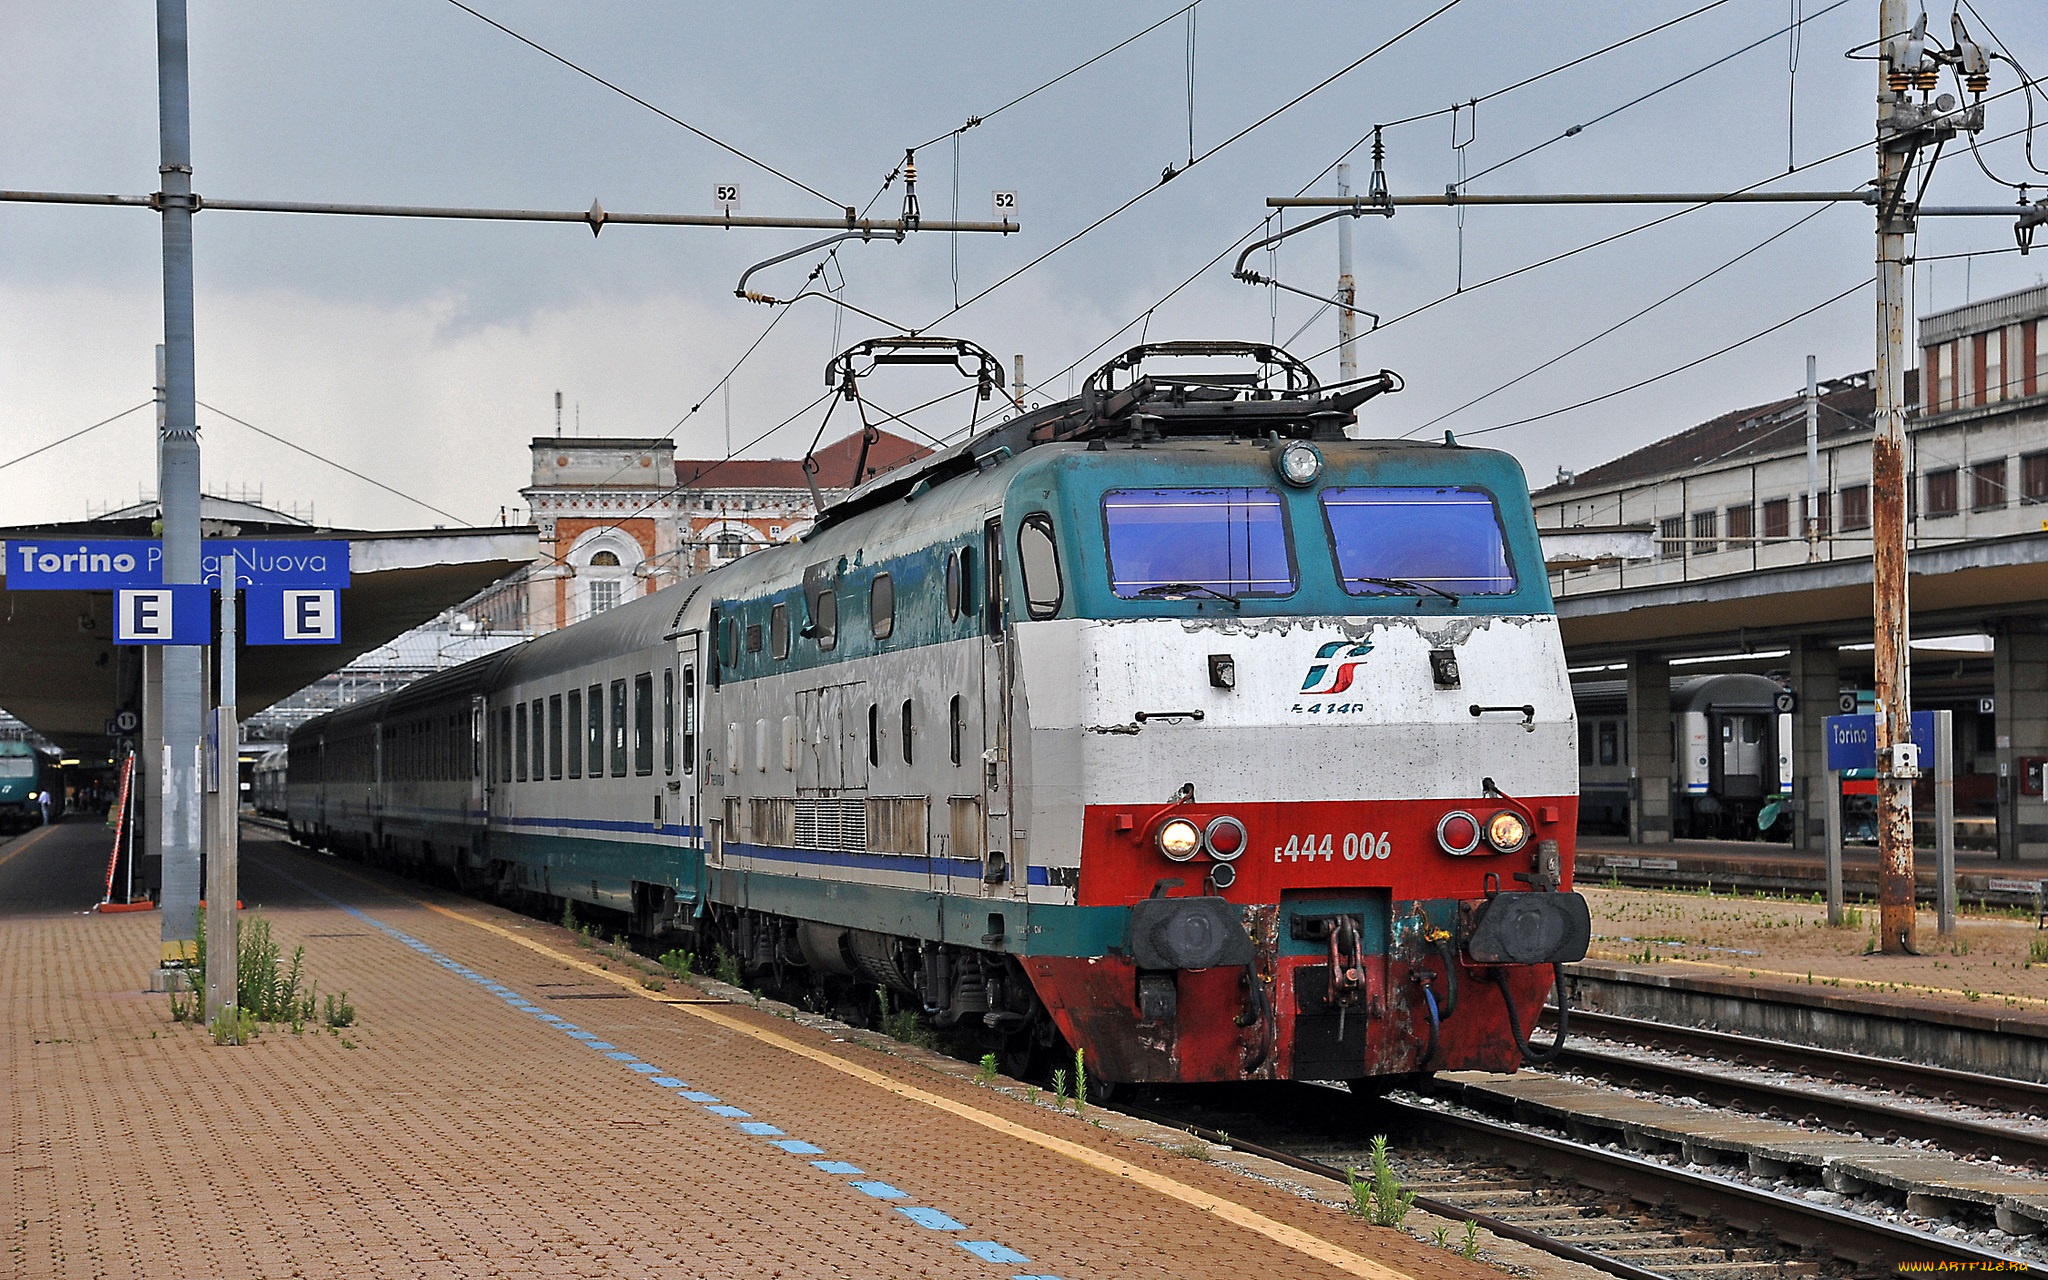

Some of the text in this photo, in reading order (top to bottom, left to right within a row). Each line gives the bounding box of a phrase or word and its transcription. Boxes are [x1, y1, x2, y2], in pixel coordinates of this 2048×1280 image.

[717, 186, 737, 201] 52
[995, 193, 1014, 207] 52
[18, 546, 135, 573] Torino
[233, 547, 326, 572] Nuova
[133, 595, 158, 634] E
[296, 595, 321, 634] E
[1982, 700, 1993, 711] D
[1833, 724, 1867, 744] Torino
[1343, 832, 1391, 861] 006
